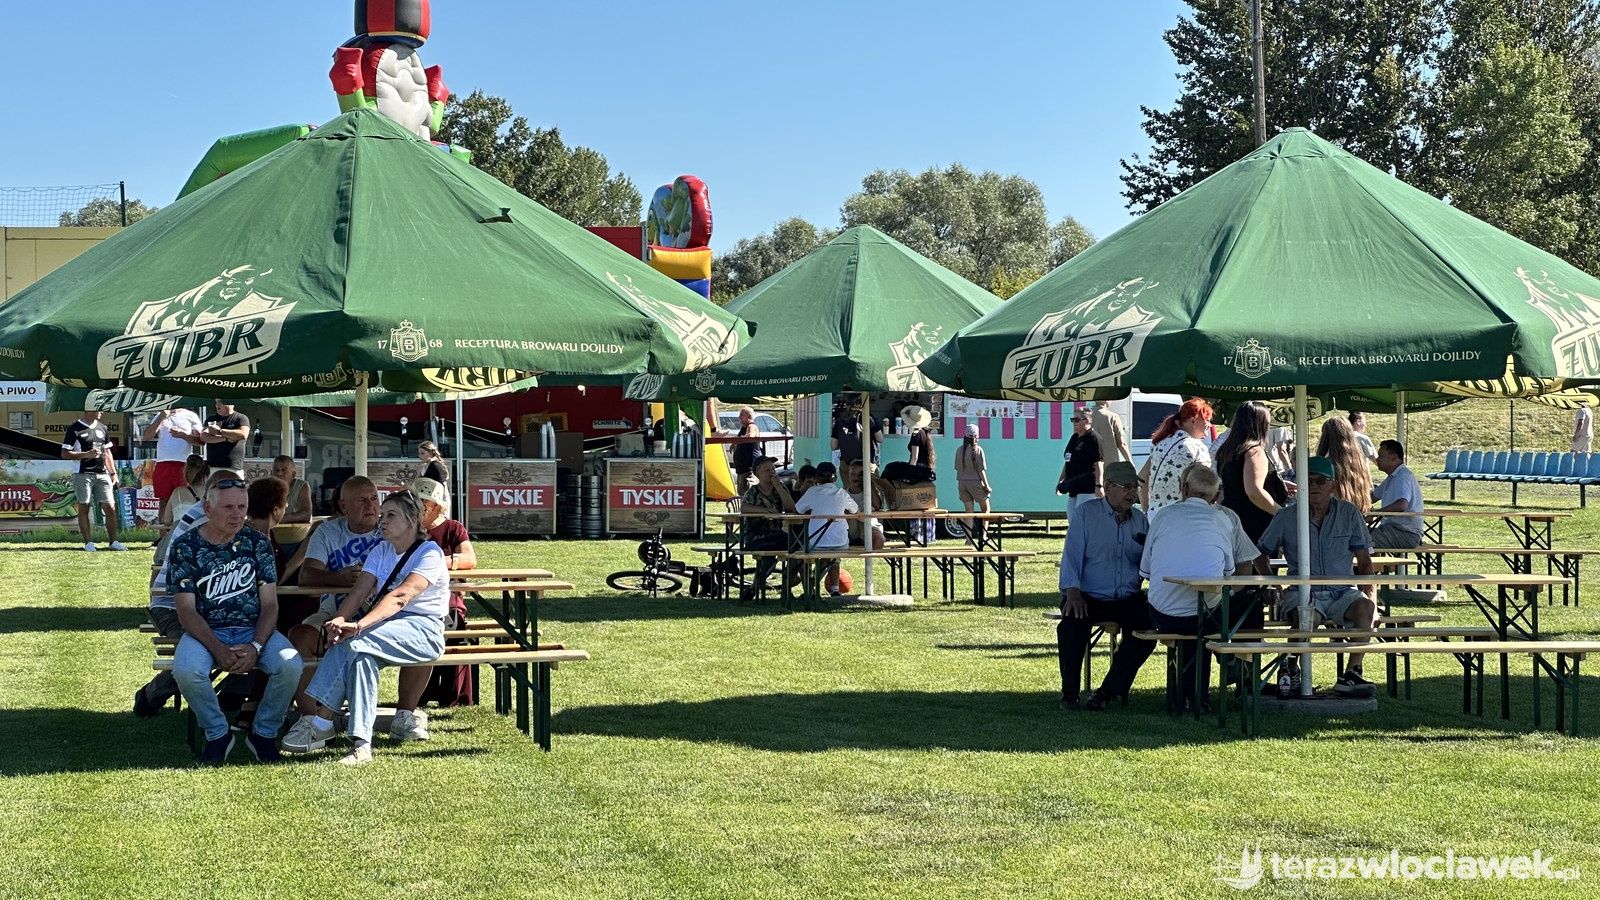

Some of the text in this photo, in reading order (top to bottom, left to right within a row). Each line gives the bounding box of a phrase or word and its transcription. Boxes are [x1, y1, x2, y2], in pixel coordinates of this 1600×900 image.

[377, 340, 388, 350] 17
[429, 339, 443, 348] 68
[454, 338, 519, 350] RECEPTURA
[521, 340, 578, 352] BROWARU
[580, 342, 625, 354] DOJLIDY
[1223, 356, 1233, 366] 17
[1273, 356, 1287, 366] 68
[1298, 355, 1366, 366] RECEPTURA
[1368, 352, 1430, 365] BROWARU
[1432, 350, 1482, 362] DOJLIDY
[730, 377, 768, 386] RECEPTURA
[768, 375, 801, 385] BROWARU
[801, 373, 829, 384] DOJLIDY
[7, 387, 36, 395] PIWO
[0, 486, 32, 502] ring
[479, 489, 544, 505] TYSKIE
[619, 489, 685, 505] TYSKIE
[0, 500, 40, 512] ODYL
[222, 560, 237, 575] no
[197, 561, 256, 600] time
